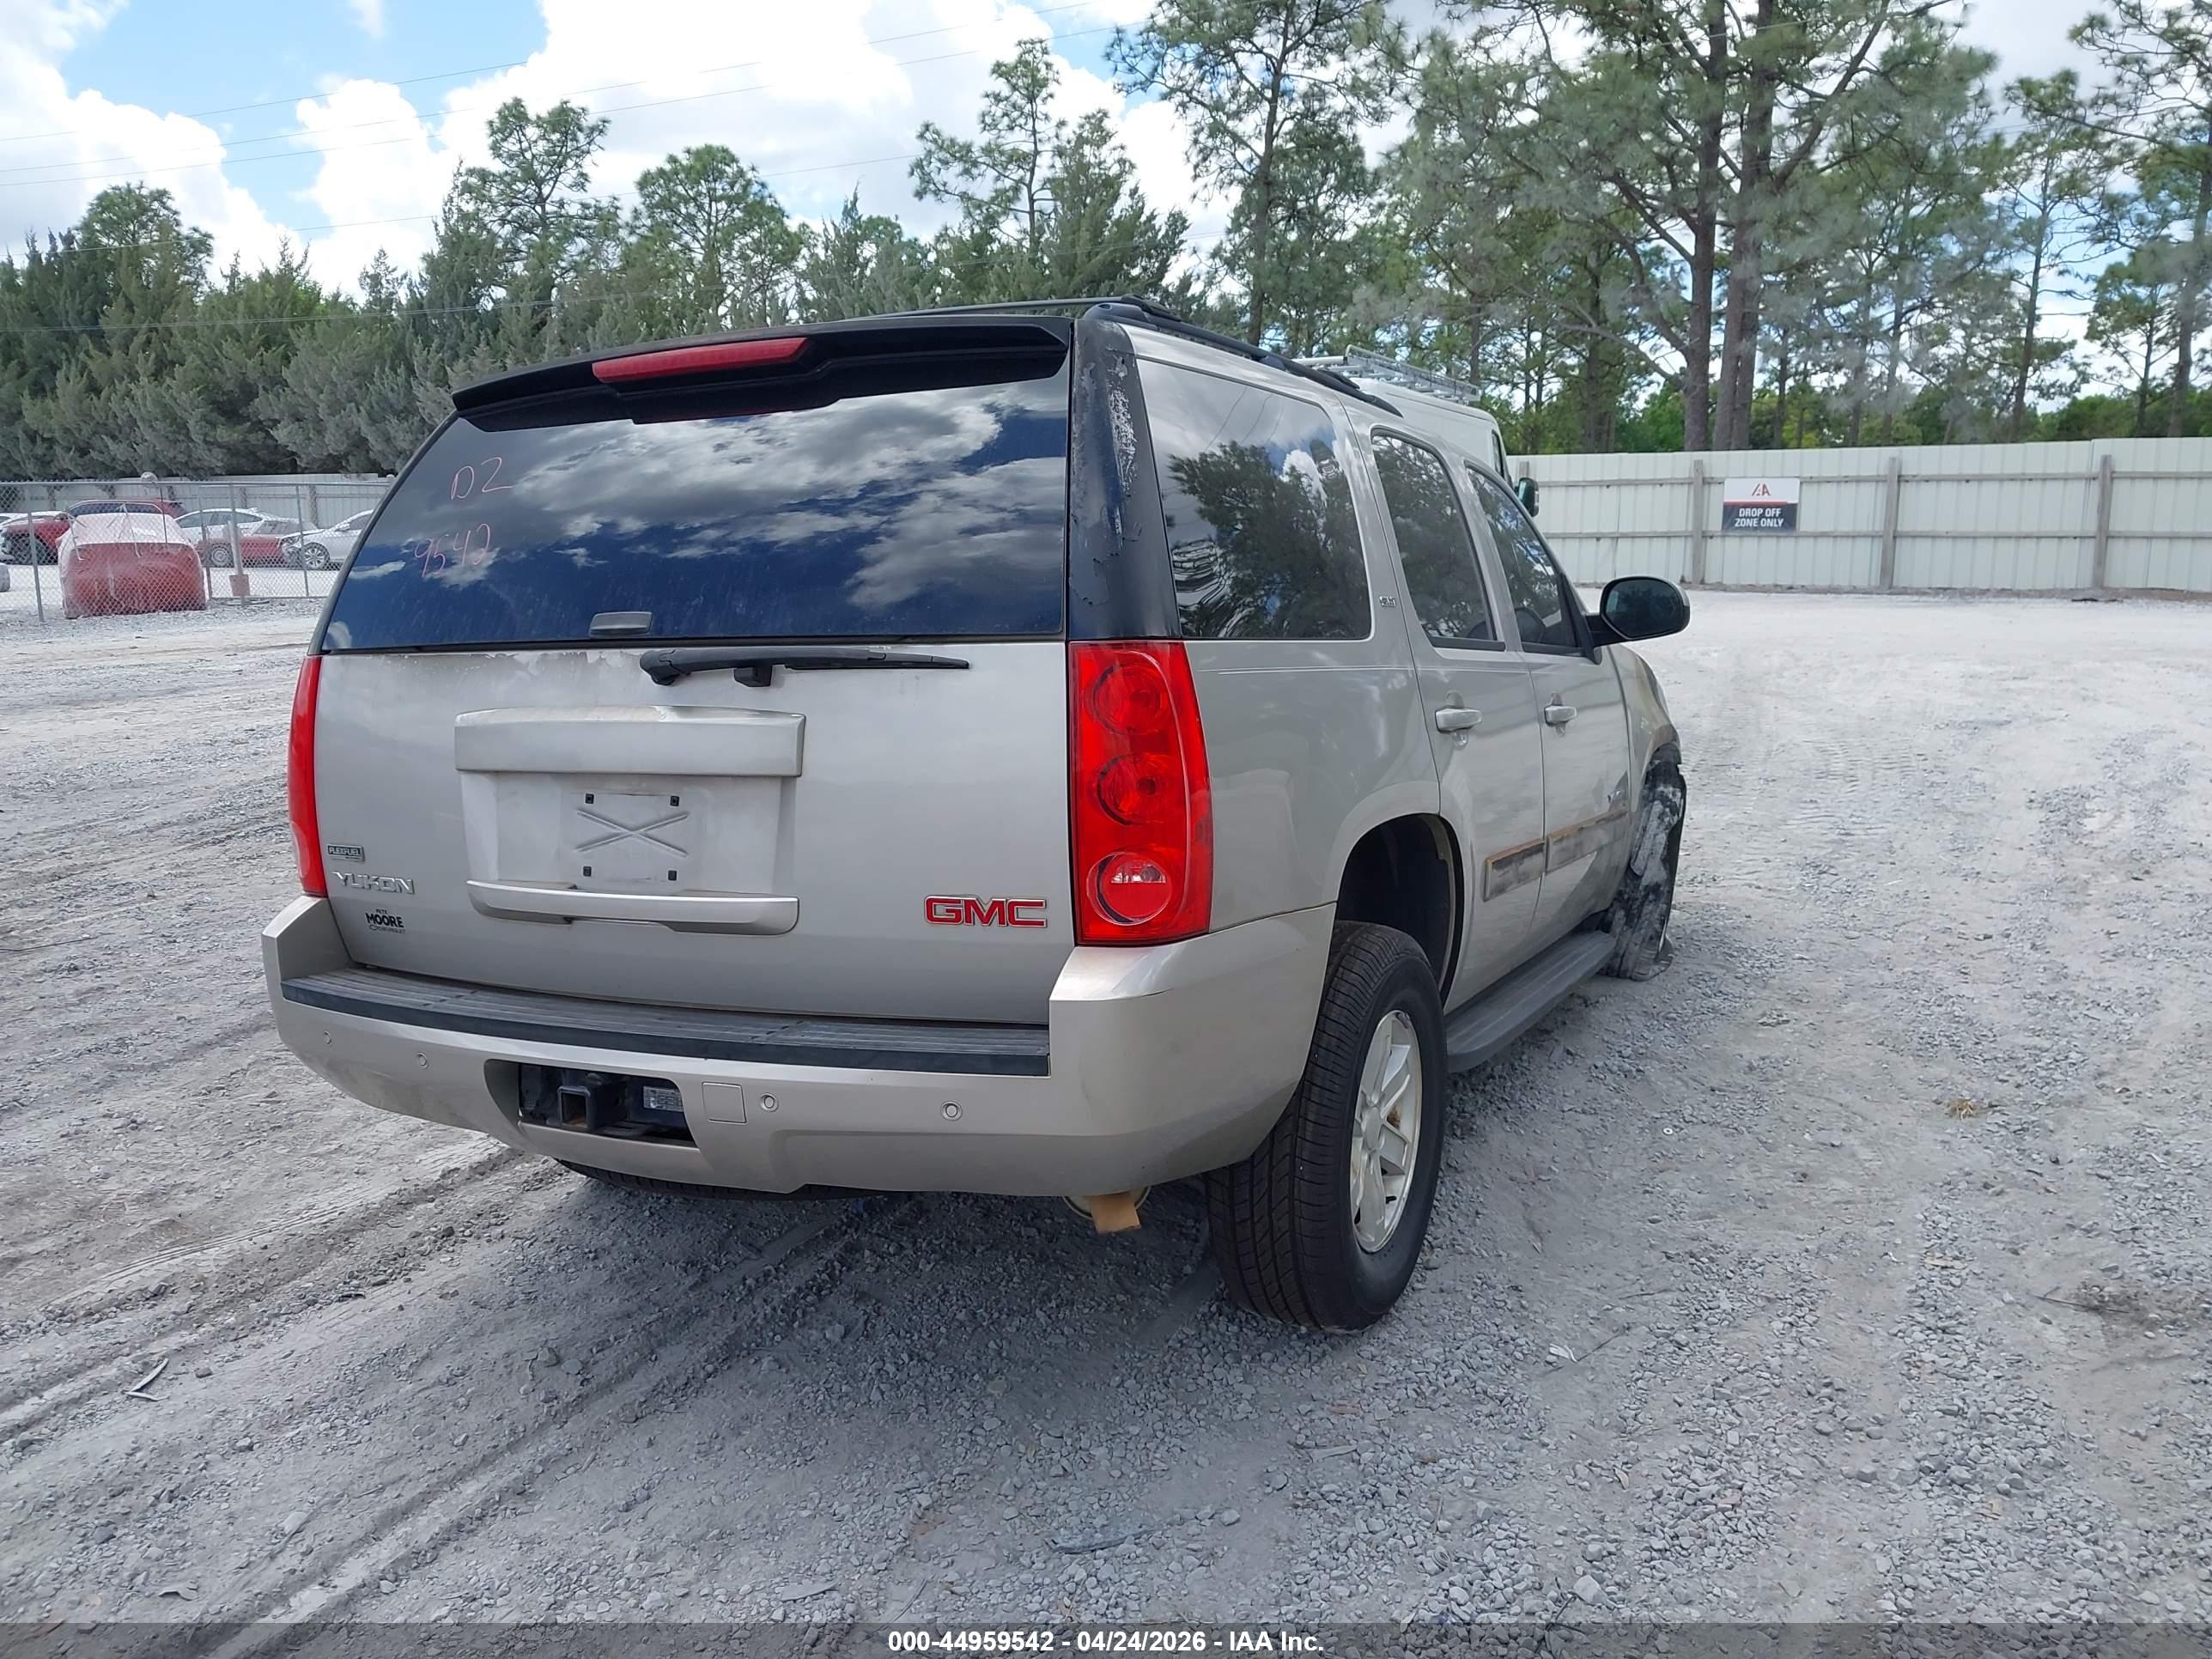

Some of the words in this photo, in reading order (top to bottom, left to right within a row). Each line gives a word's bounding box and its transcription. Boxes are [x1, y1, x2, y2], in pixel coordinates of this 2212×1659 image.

[1739, 507, 1763, 518] DROP
[1765, 507, 1782, 518] OFF
[1735, 518, 1758, 527] ZONE
[1760, 518, 1784, 527] ONLY
[414, 523, 490, 578] 9542
[332, 871, 415, 894] YUKON
[365, 912, 404, 928] MOORE
[925, 896, 1047, 927] GMC
